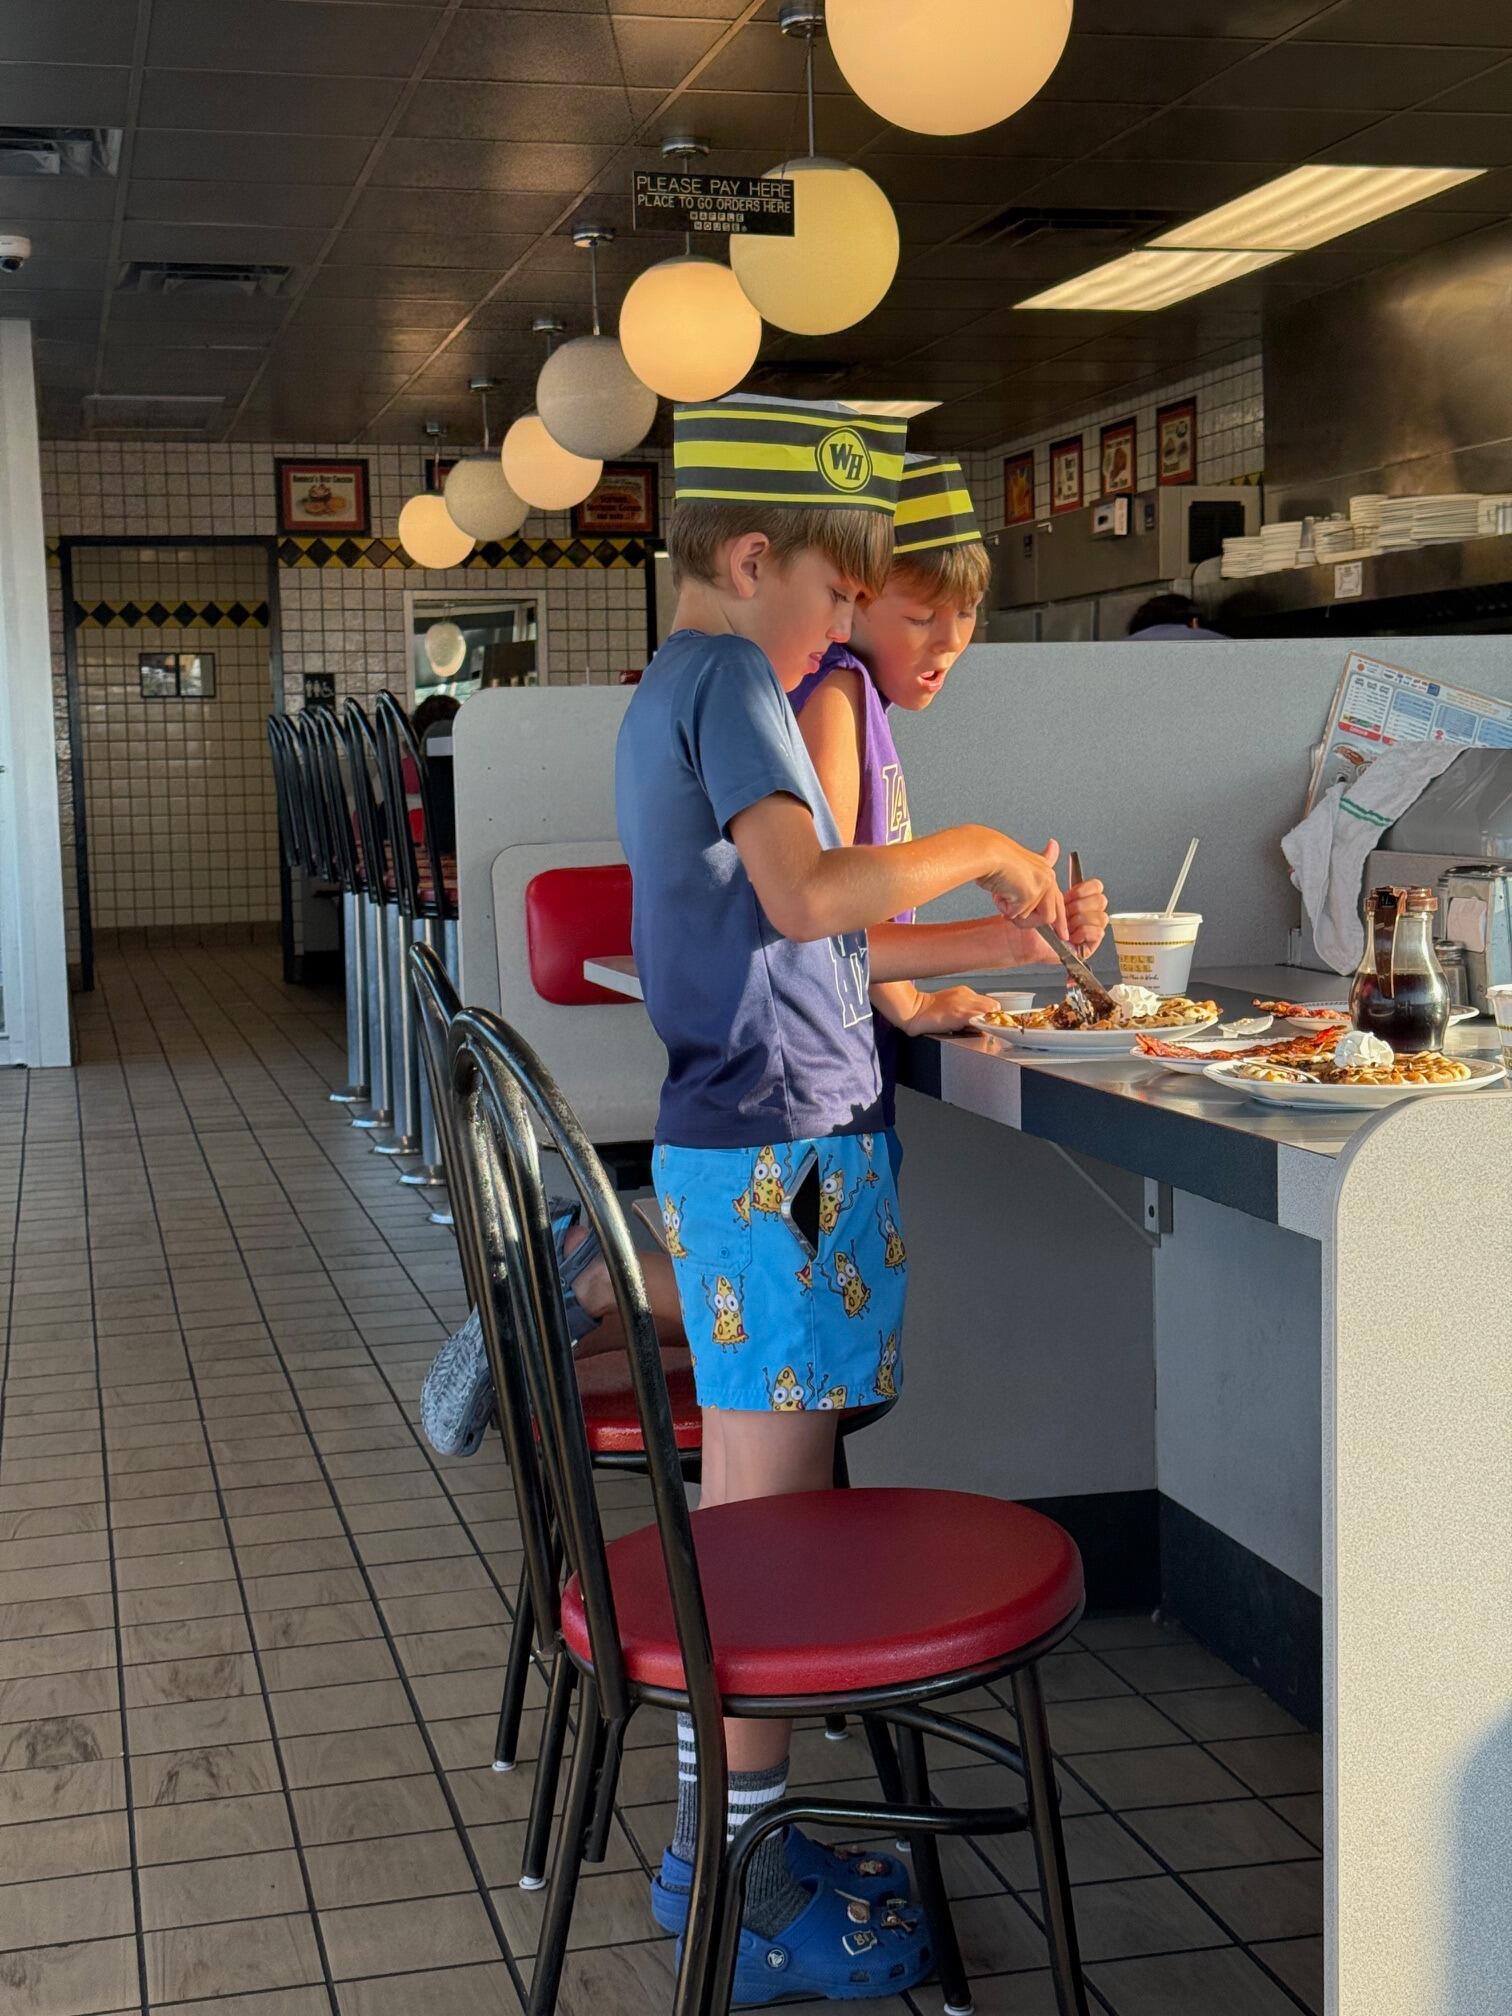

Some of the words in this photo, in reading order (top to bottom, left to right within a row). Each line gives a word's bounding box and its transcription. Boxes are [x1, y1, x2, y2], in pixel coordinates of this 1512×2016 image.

[636, 175, 701, 193] PLEASE
[710, 179, 740, 195] PAY
[749, 182, 791, 198] HERE
[637, 194, 675, 208] PLACE
[679, 196, 694, 209] TO
[697, 197, 713, 210] GO
[716, 198, 760, 212] ORDERS
[763, 200, 791, 213] HERE
